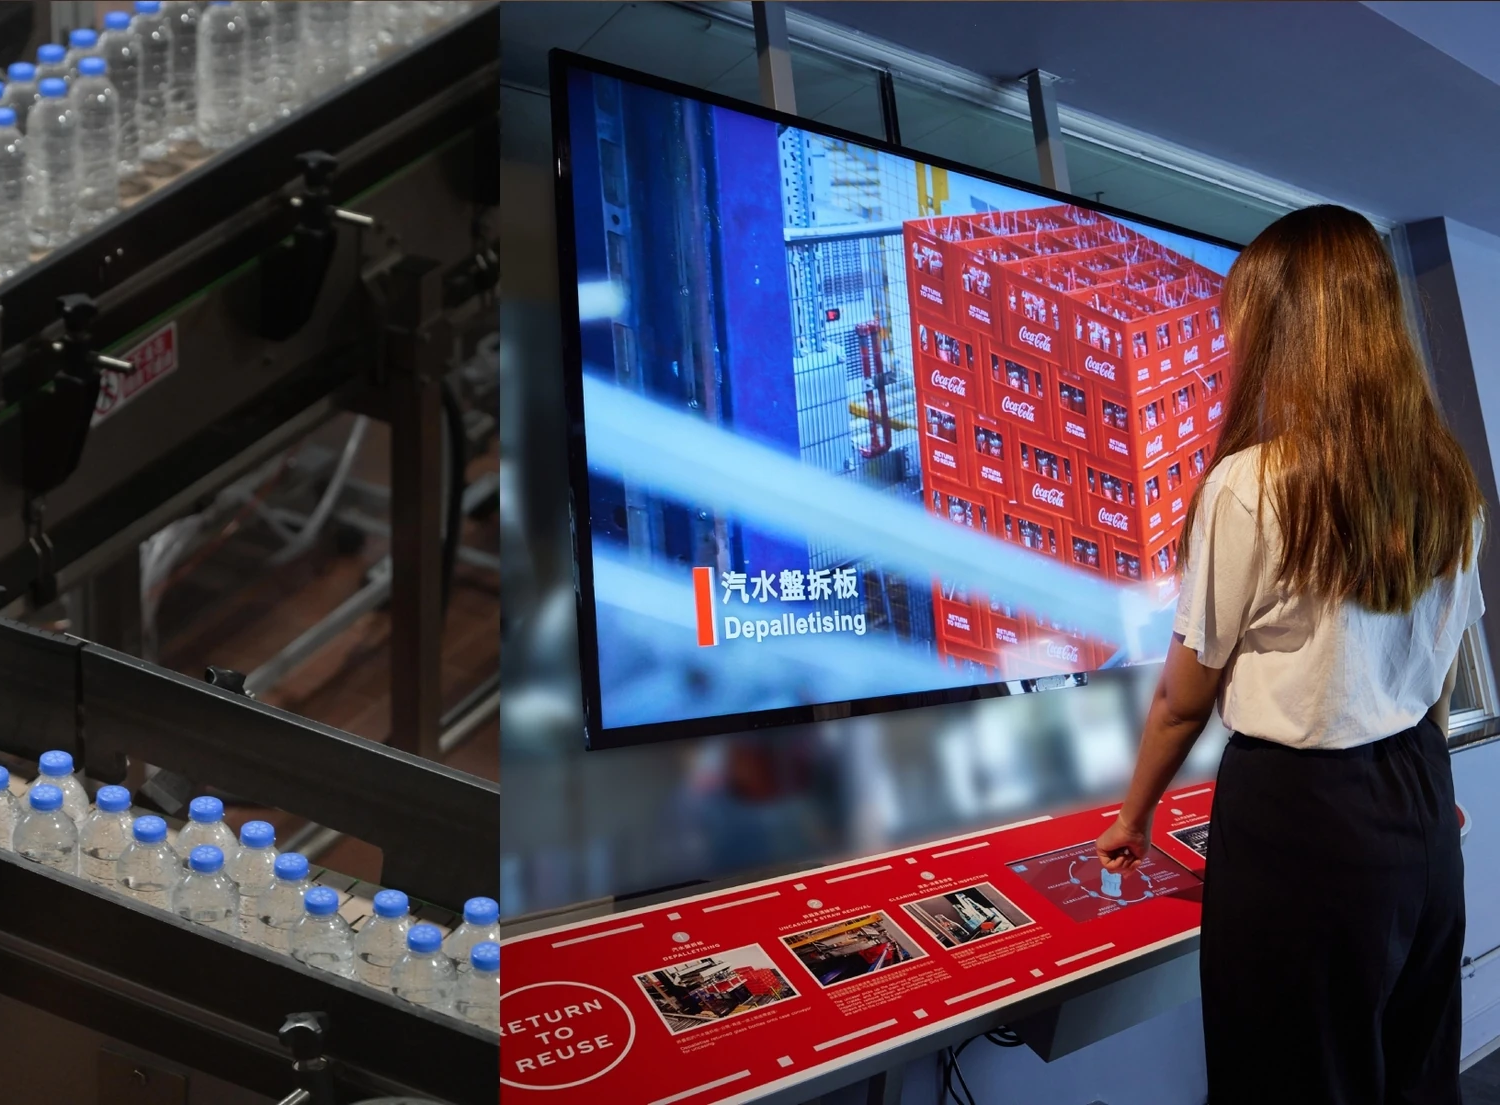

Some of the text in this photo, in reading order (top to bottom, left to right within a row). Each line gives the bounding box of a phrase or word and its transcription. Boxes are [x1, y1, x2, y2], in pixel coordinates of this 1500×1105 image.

[1019, 326, 1051, 353] Coca-Cola
[1085, 356, 1116, 381] Coca-Cola
[931, 369, 966, 397] Coca-Cola
[1002, 396, 1035, 422] Coca-Cola
[1032, 483, 1064, 508] Coca-Cola
[1098, 507, 1128, 531] Coca-Cola
[721, 568, 859, 606] 汽水盤拆板
[724, 610, 866, 641] Depalletising
[1047, 641, 1079, 663] Coca-Cola
[778, 904, 872, 931] UNCASING STRAW REMOVAL
[662, 943, 721, 962] DEPALLETISING
[534, 1026, 574, 1045] TO
[515, 1034, 614, 1073] REUSE
